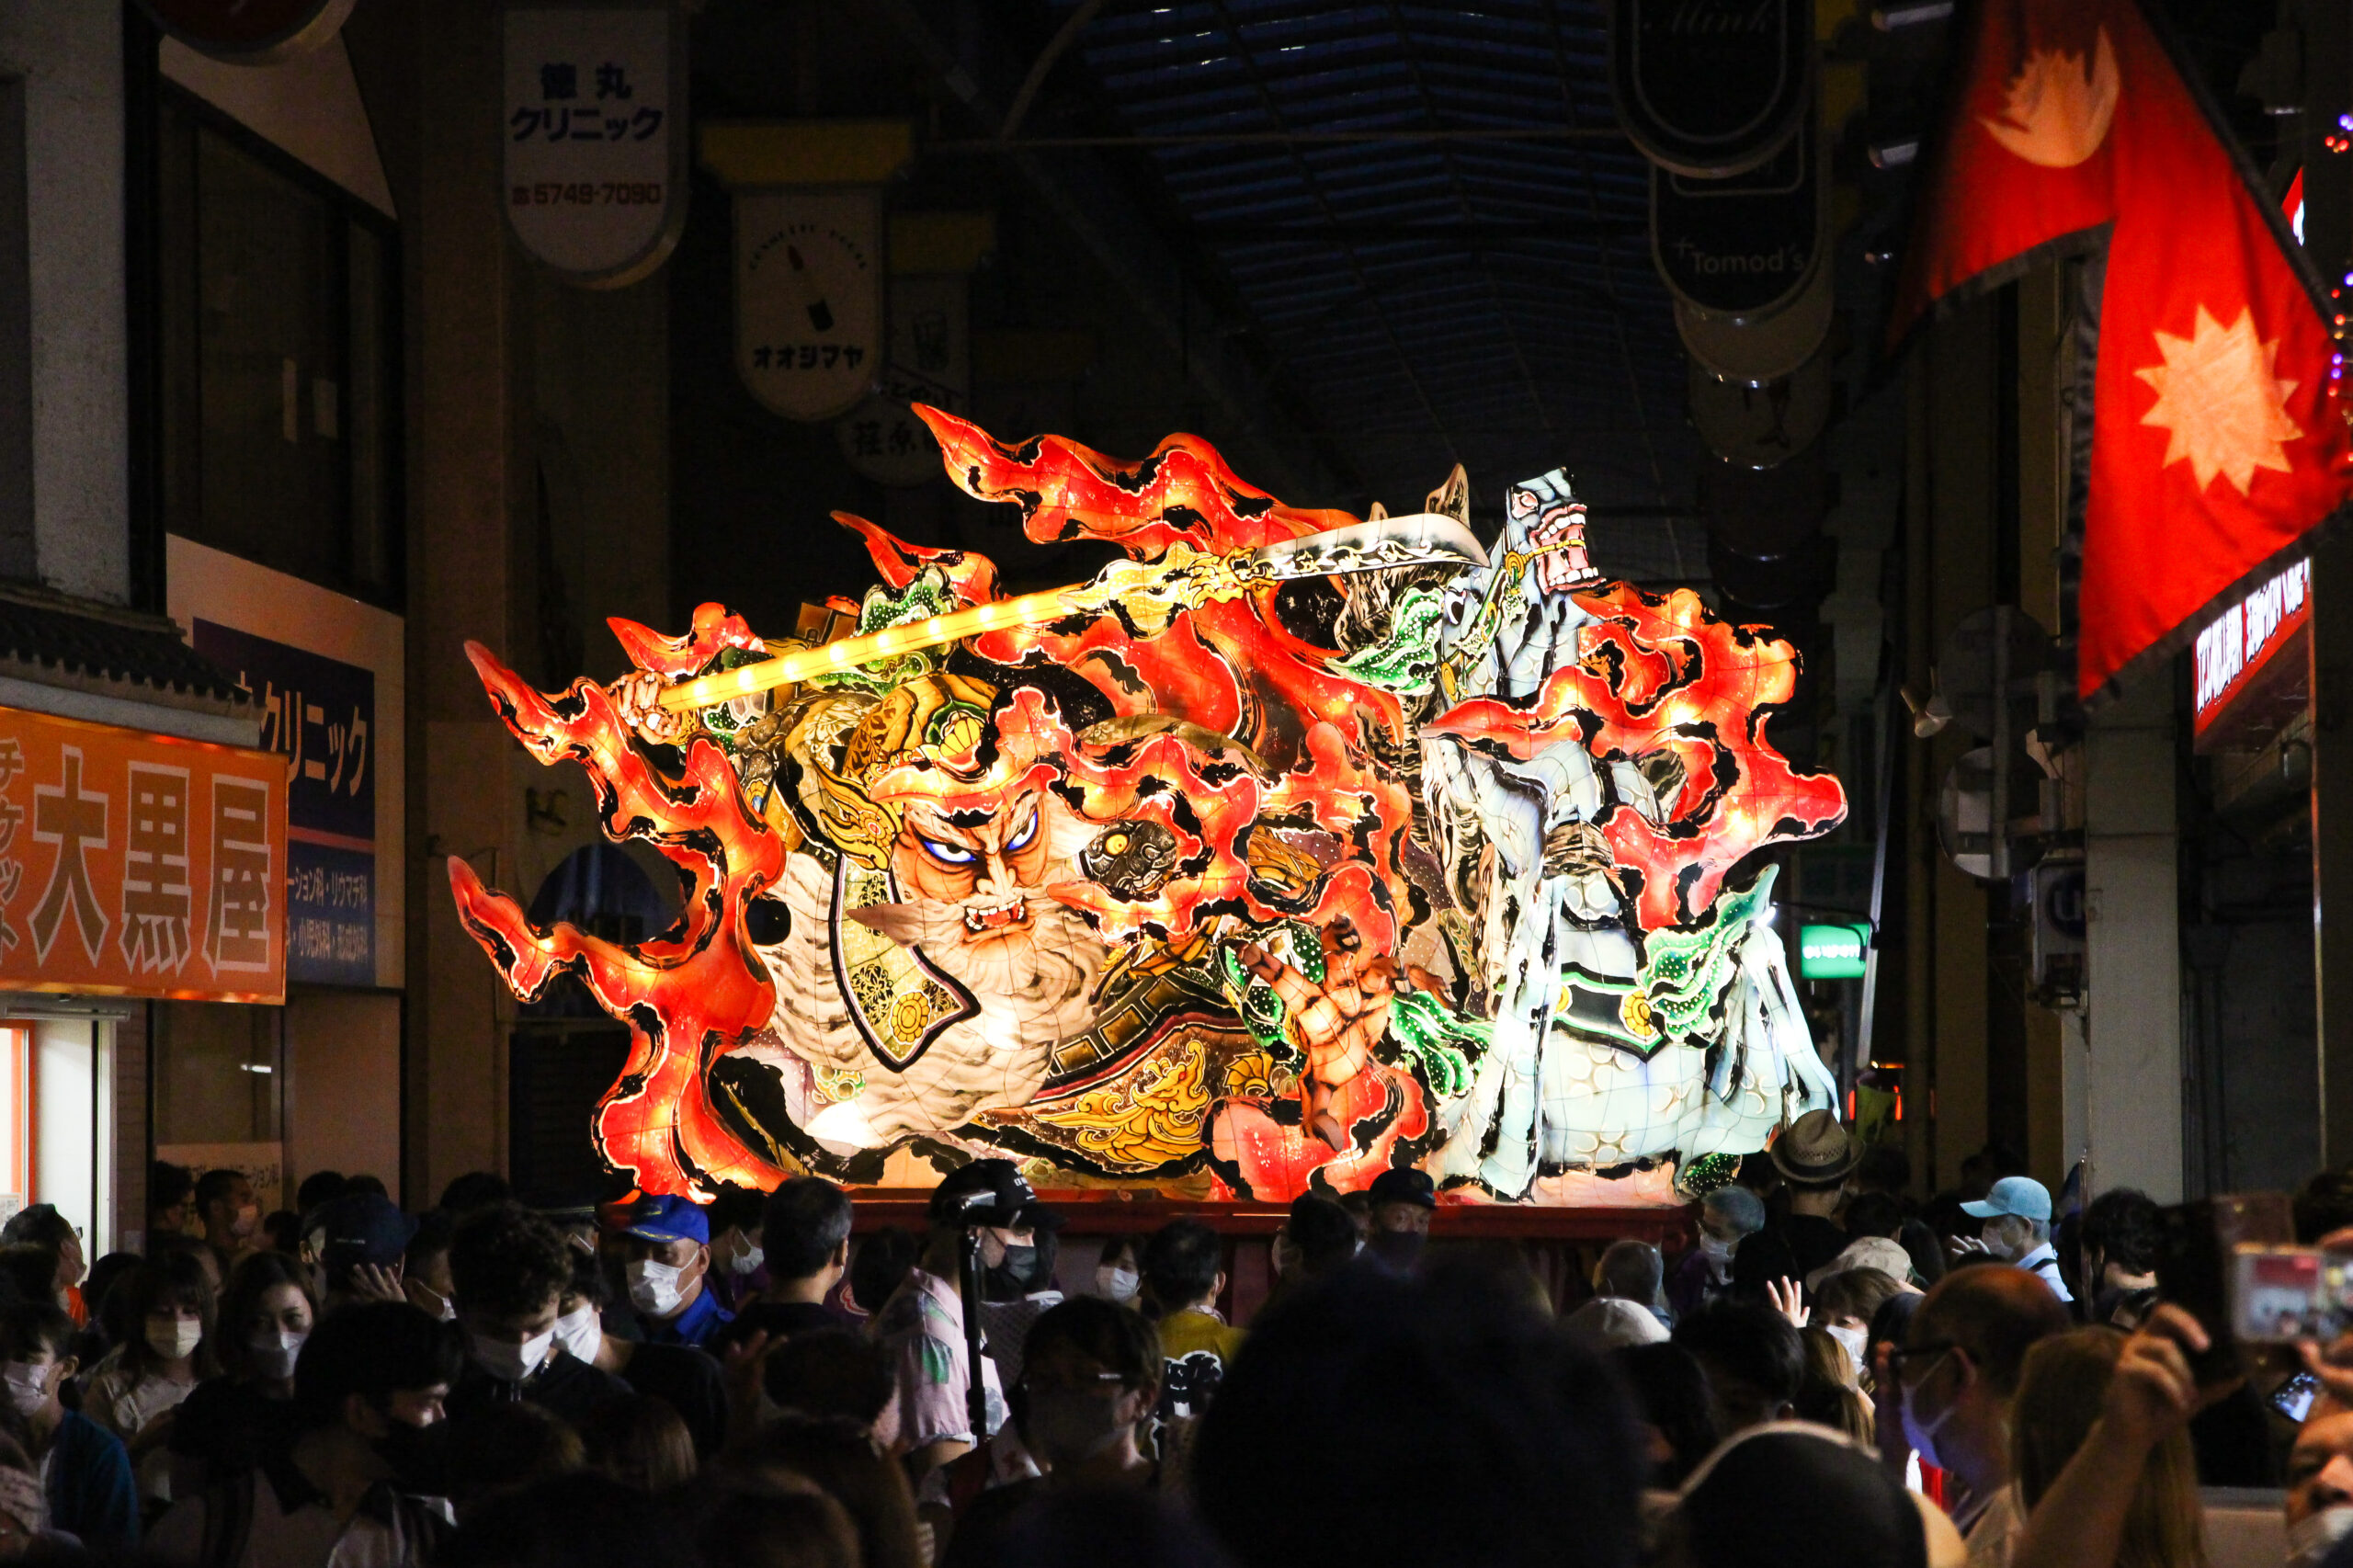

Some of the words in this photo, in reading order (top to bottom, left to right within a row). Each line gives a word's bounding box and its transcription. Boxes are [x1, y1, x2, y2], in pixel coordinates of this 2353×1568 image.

[510, 107, 663, 142] クリニック
[1689, 242, 1803, 275] Tomod's
[27, 743, 271, 982] 大黒屋
